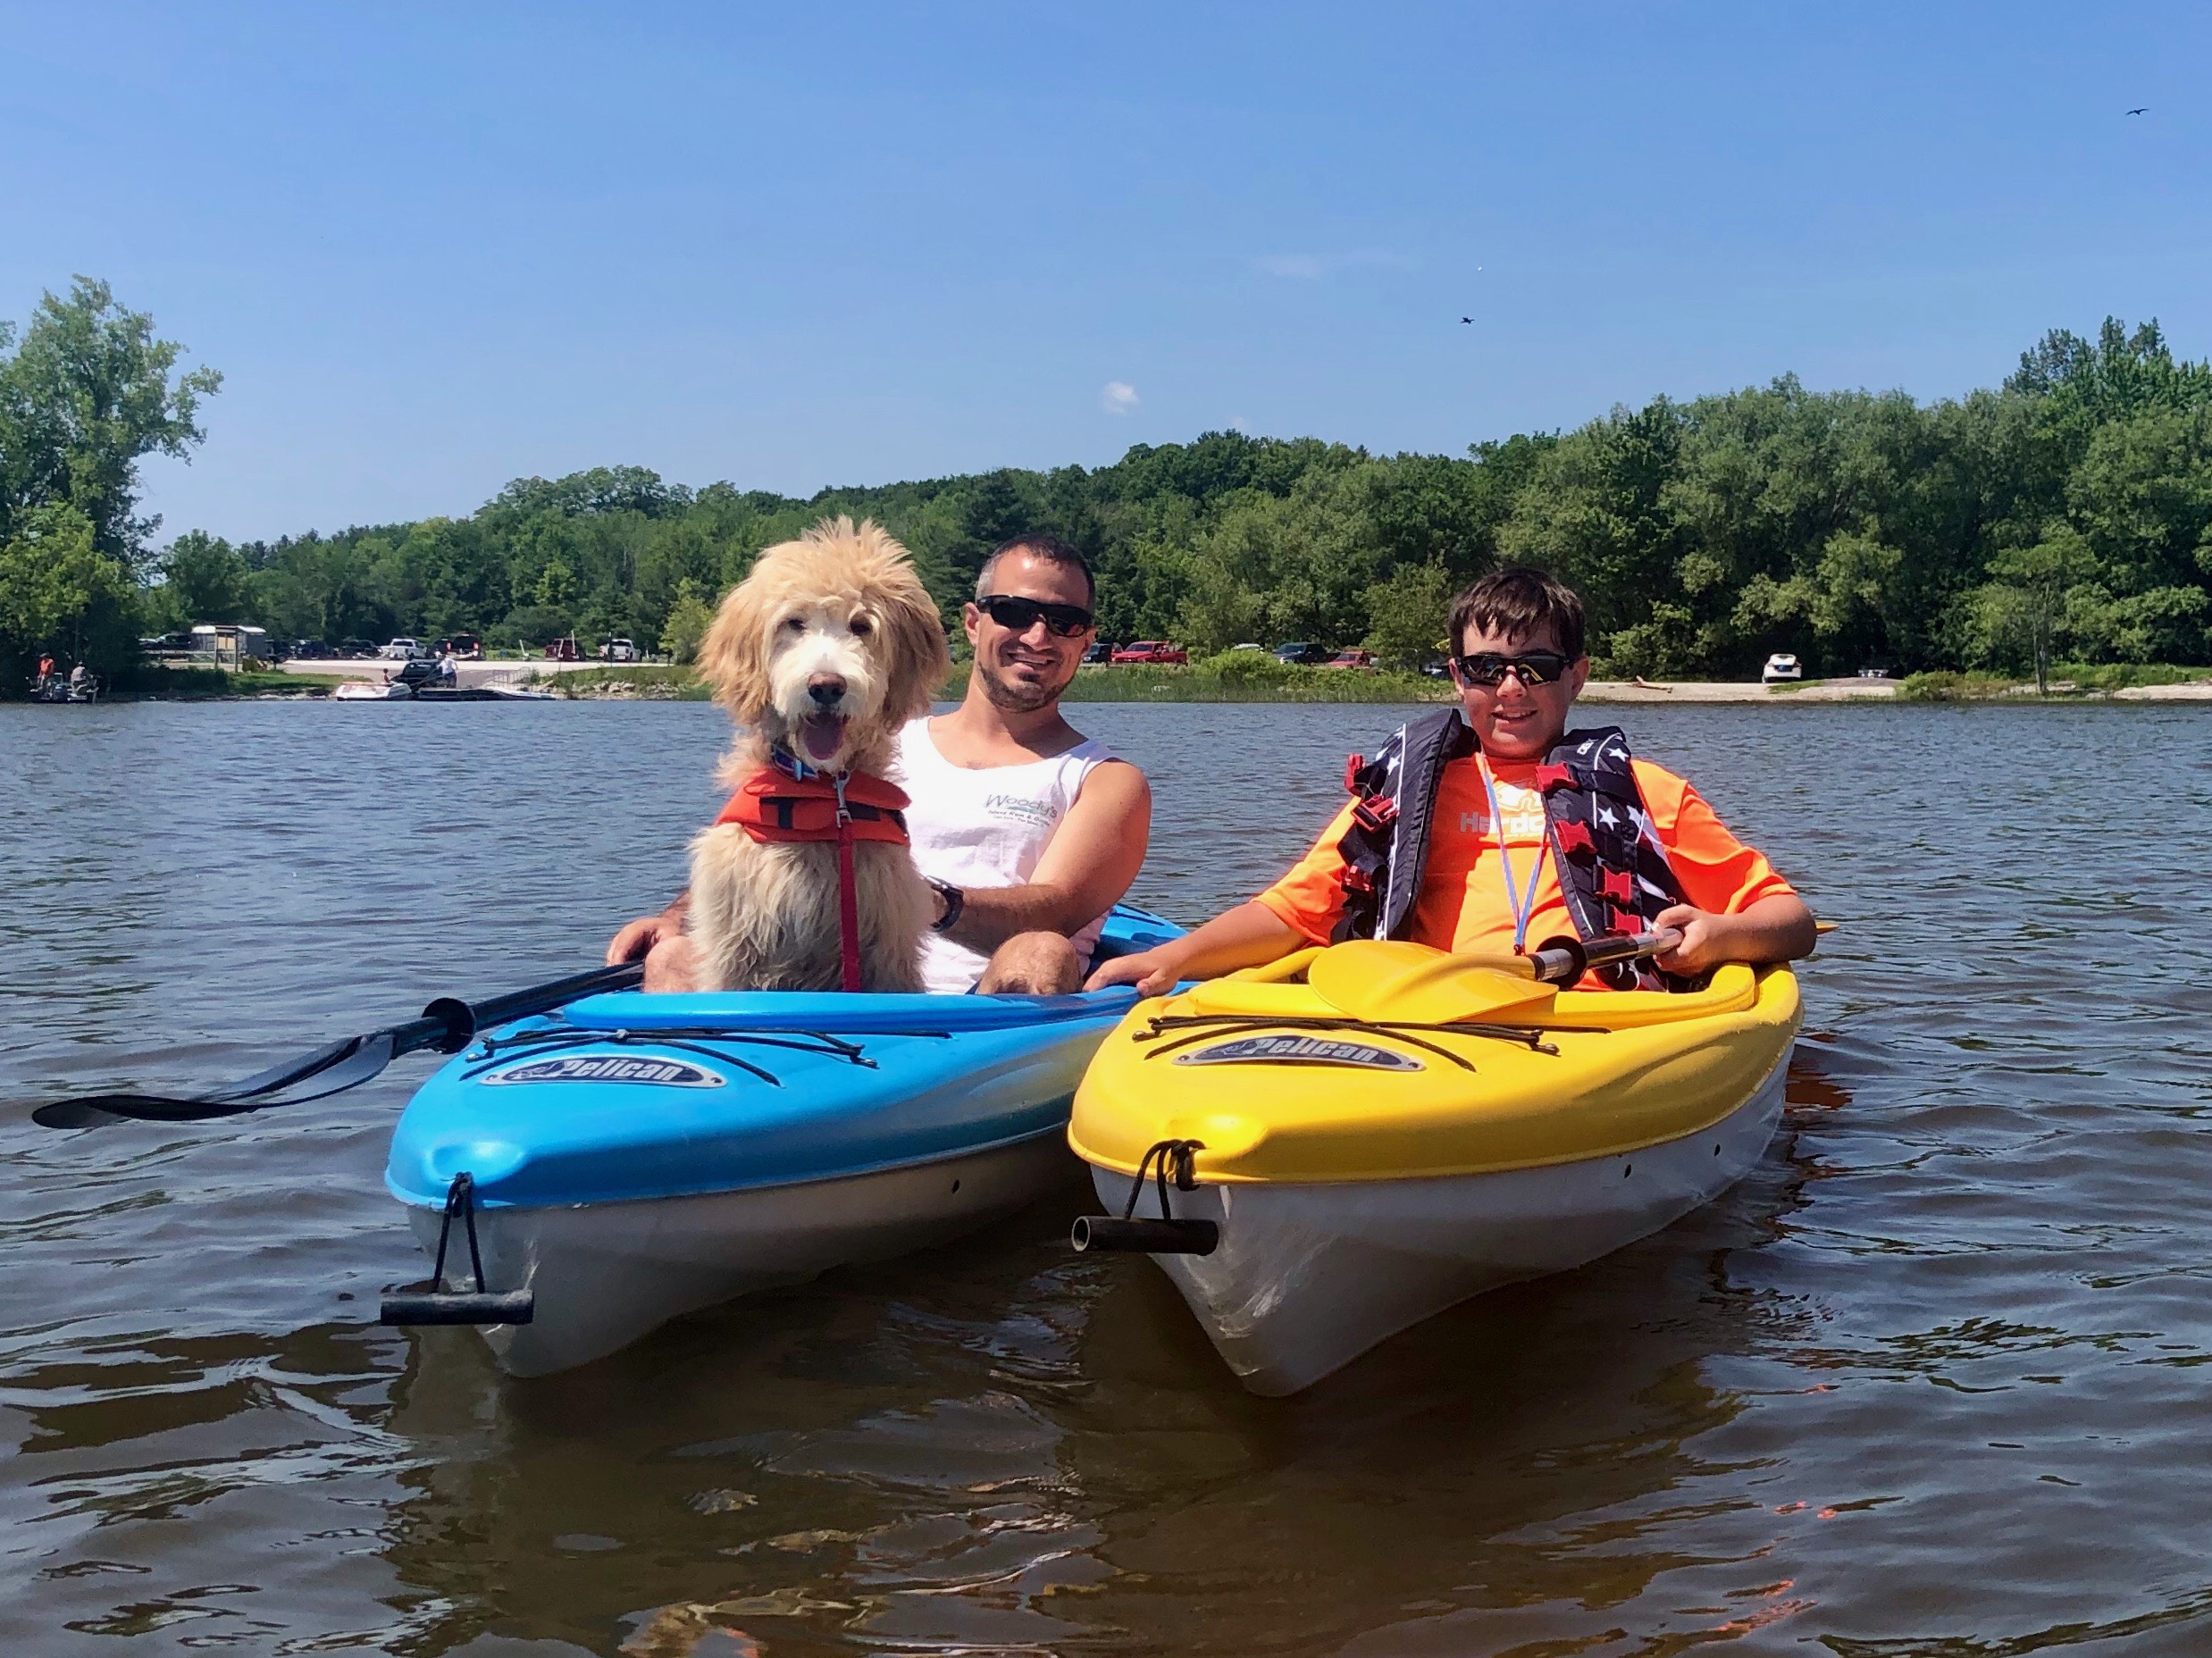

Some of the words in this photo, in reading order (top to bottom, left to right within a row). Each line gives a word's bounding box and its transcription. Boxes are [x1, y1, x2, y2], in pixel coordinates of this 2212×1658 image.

[985, 794, 1058, 819] Woody's
[1246, 1037, 1379, 1062] Pelican
[560, 1059, 683, 1081] Pelican
